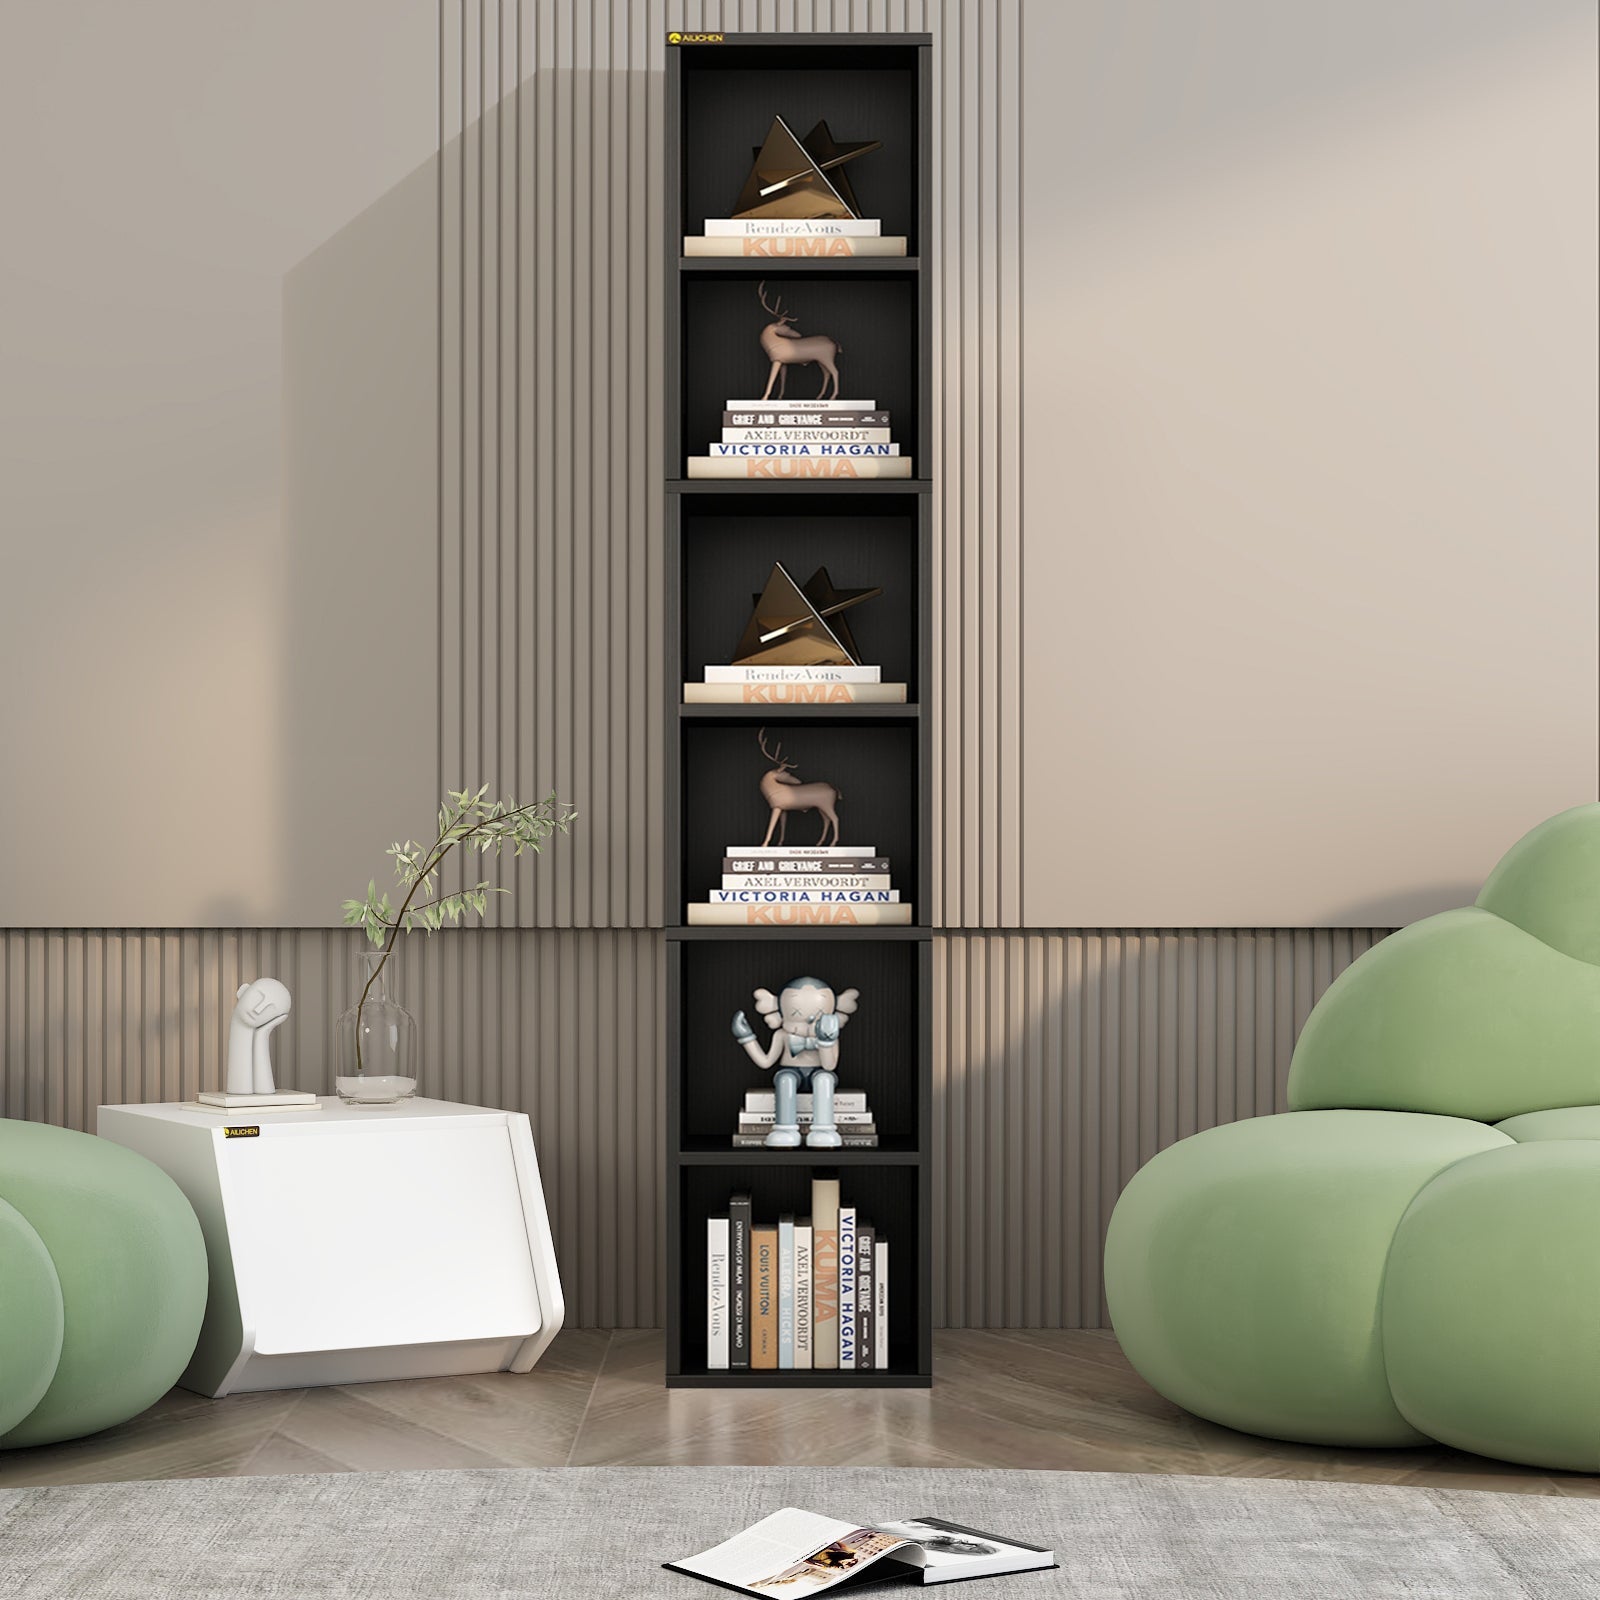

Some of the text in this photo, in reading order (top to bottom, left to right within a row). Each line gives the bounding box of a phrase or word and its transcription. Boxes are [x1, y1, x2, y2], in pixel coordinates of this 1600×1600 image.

[745, 222, 842, 234] Rendez-Vous
[743, 238, 853, 256] KUMA
[732, 414, 823, 425] GRIEF AND GRIEVANCE
[744, 430, 869, 441] AXEL VERVOORDT
[718, 445, 890, 456] VICTORIA HAGAN
[746, 458, 858, 478] KUMA
[745, 669, 842, 681] Rendez-Vous
[743, 684, 853, 703] KUMA
[732, 860, 756, 871] GRIEF
[757, 860, 775, 871] AND
[778, 860, 823, 871] GRIEVANCE
[744, 876, 869, 887] AXEL VERVOORDT
[718, 891, 890, 902] VICTORIA HAGAN
[746, 904, 858, 924] KUMA
[230, 1128, 258, 1136] AILICHEN
[735, 1265, 743, 1285] MILAN
[760, 1244, 769, 1316] LOUIS VUITTON
[814, 1230, 837, 1324] KUMA
[858, 1235, 871, 1313] GRIEF AND GRIEVANCE
[711, 1253, 725, 1336] Rendez-Vous
[781, 1247, 791, 1344] ALLEGRA HICKS
[797, 1245, 808, 1351] AXEL VERVOORDT
[842, 1216, 854, 1361] VICTORIA HAGAN
[735, 1323, 743, 1348] MILANO
